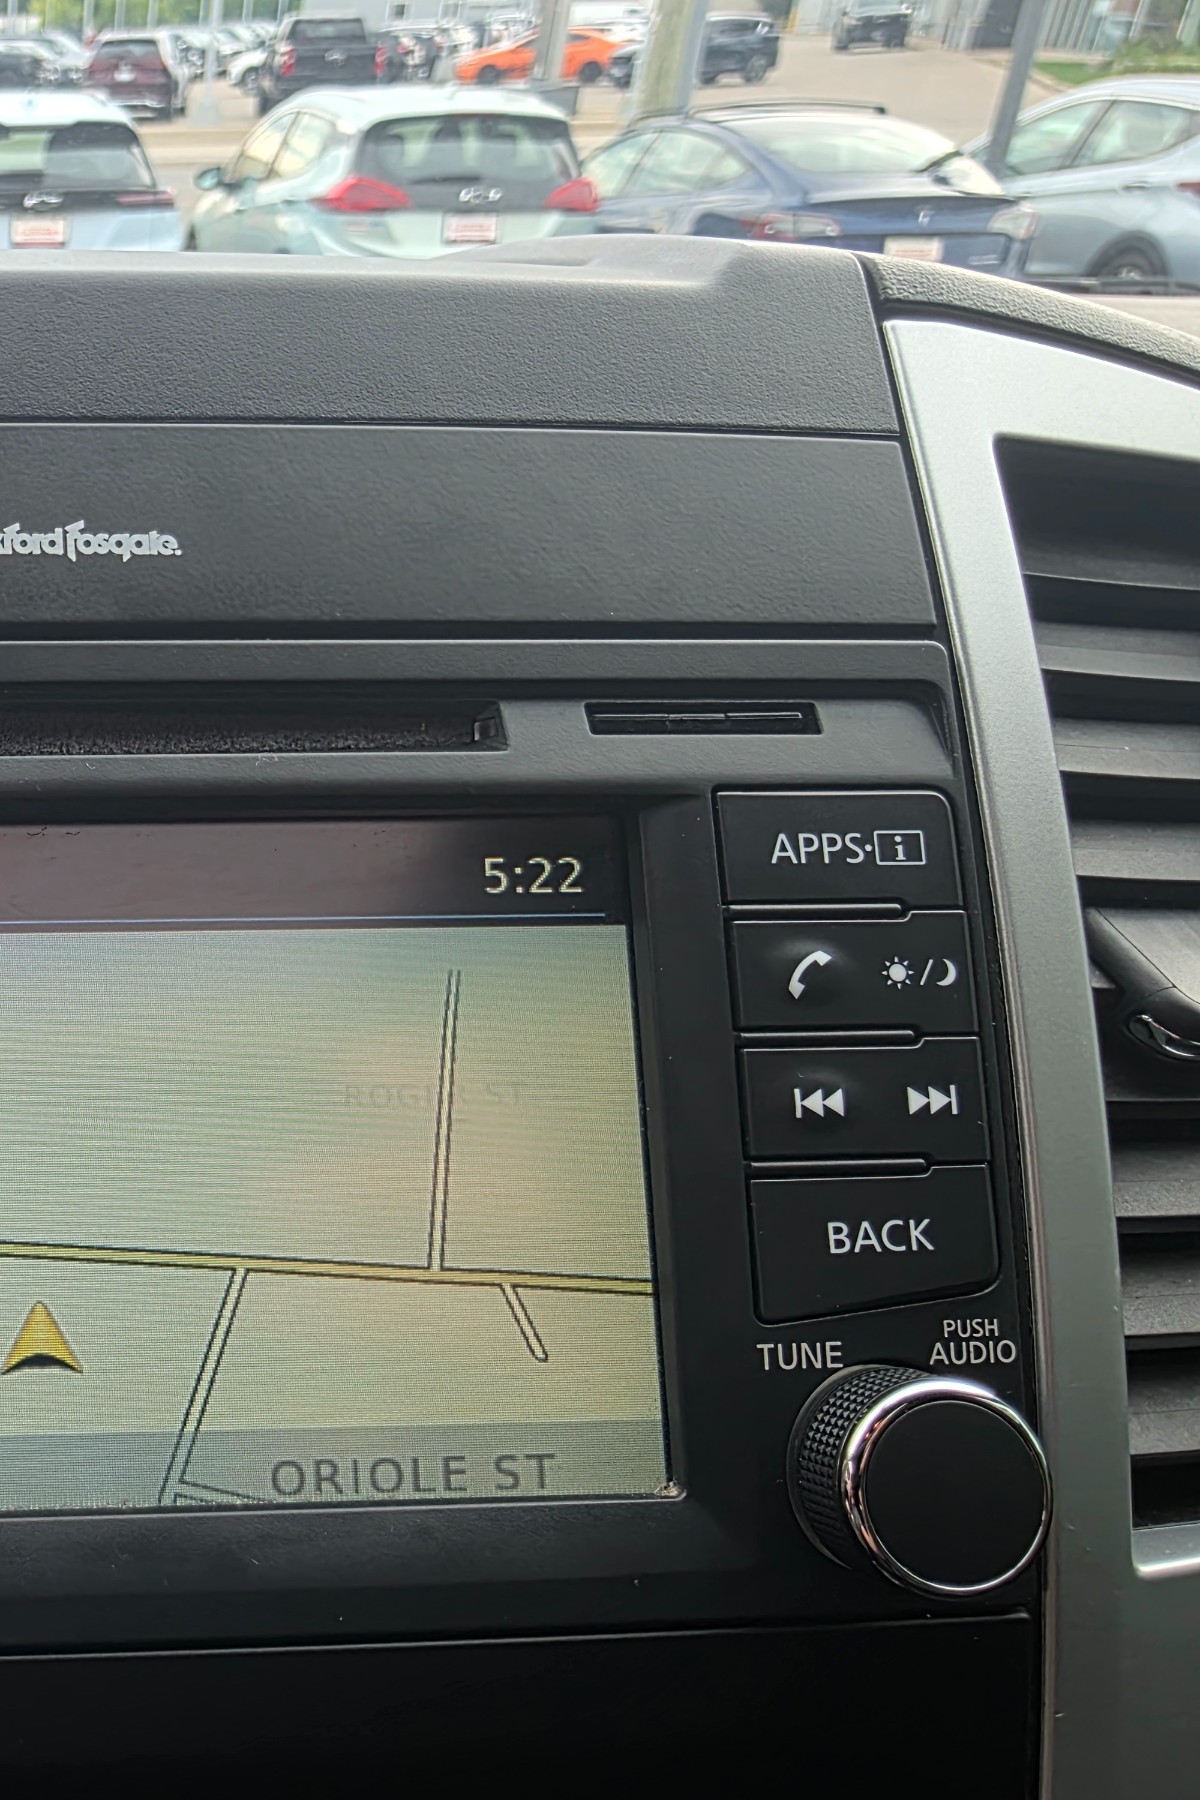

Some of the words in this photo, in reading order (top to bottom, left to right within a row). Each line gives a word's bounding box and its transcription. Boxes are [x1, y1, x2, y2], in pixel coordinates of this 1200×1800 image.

[484, 857, 583, 893] 5:22
[827, 1218, 934, 1254] BACK
[943, 1318, 999, 1338] PUSH
[757, 1341, 844, 1371] TUNE
[929, 1339, 1017, 1366] AUDIO
[271, 1455, 469, 1496] ORIOLE
[493, 1452, 556, 1490] ST
